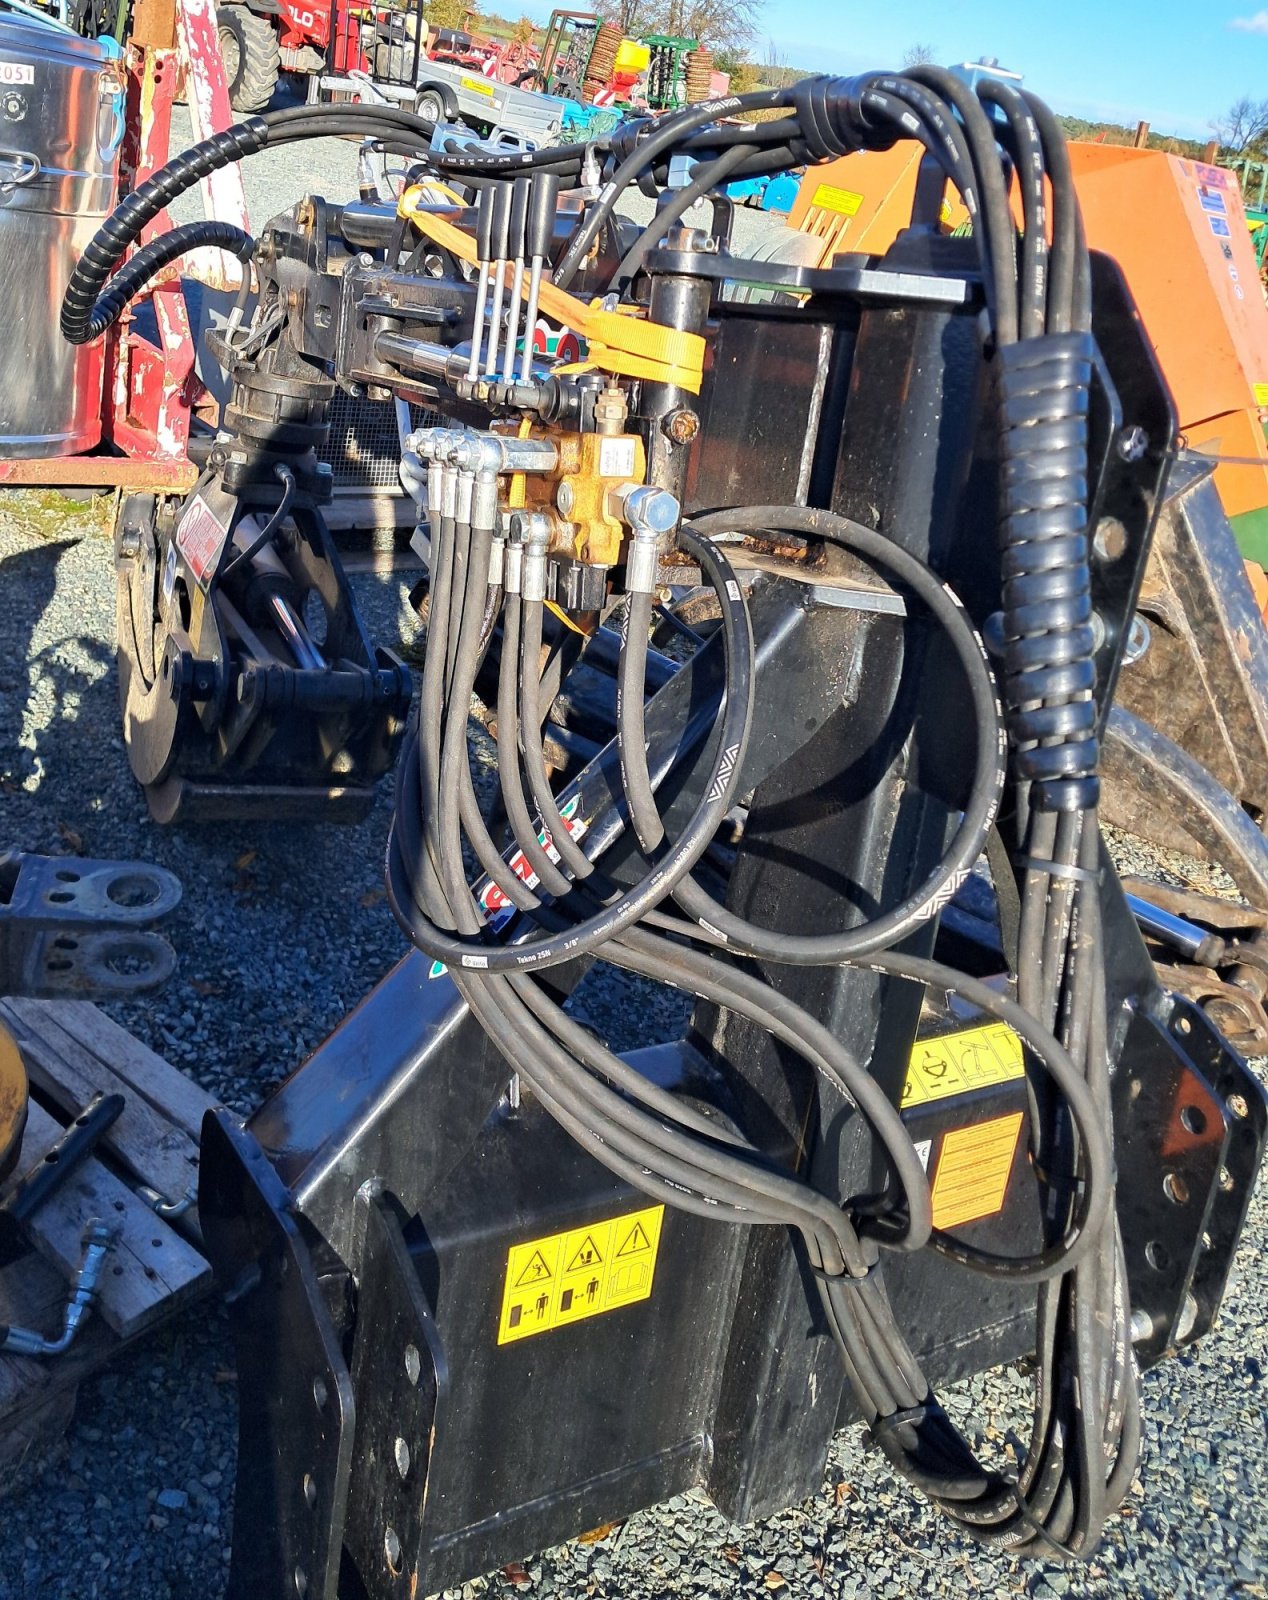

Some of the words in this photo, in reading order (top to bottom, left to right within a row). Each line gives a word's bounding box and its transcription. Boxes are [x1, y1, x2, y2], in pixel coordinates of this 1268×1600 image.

[0, 66, 31, 81] 051
[674, 846, 691, 866] 4780
[685, 836, 699, 850] Psi
[516, 952, 538, 965] Tekno
[535, 948, 552, 961] 2SN
[563, 937, 580, 951] 3/8"
